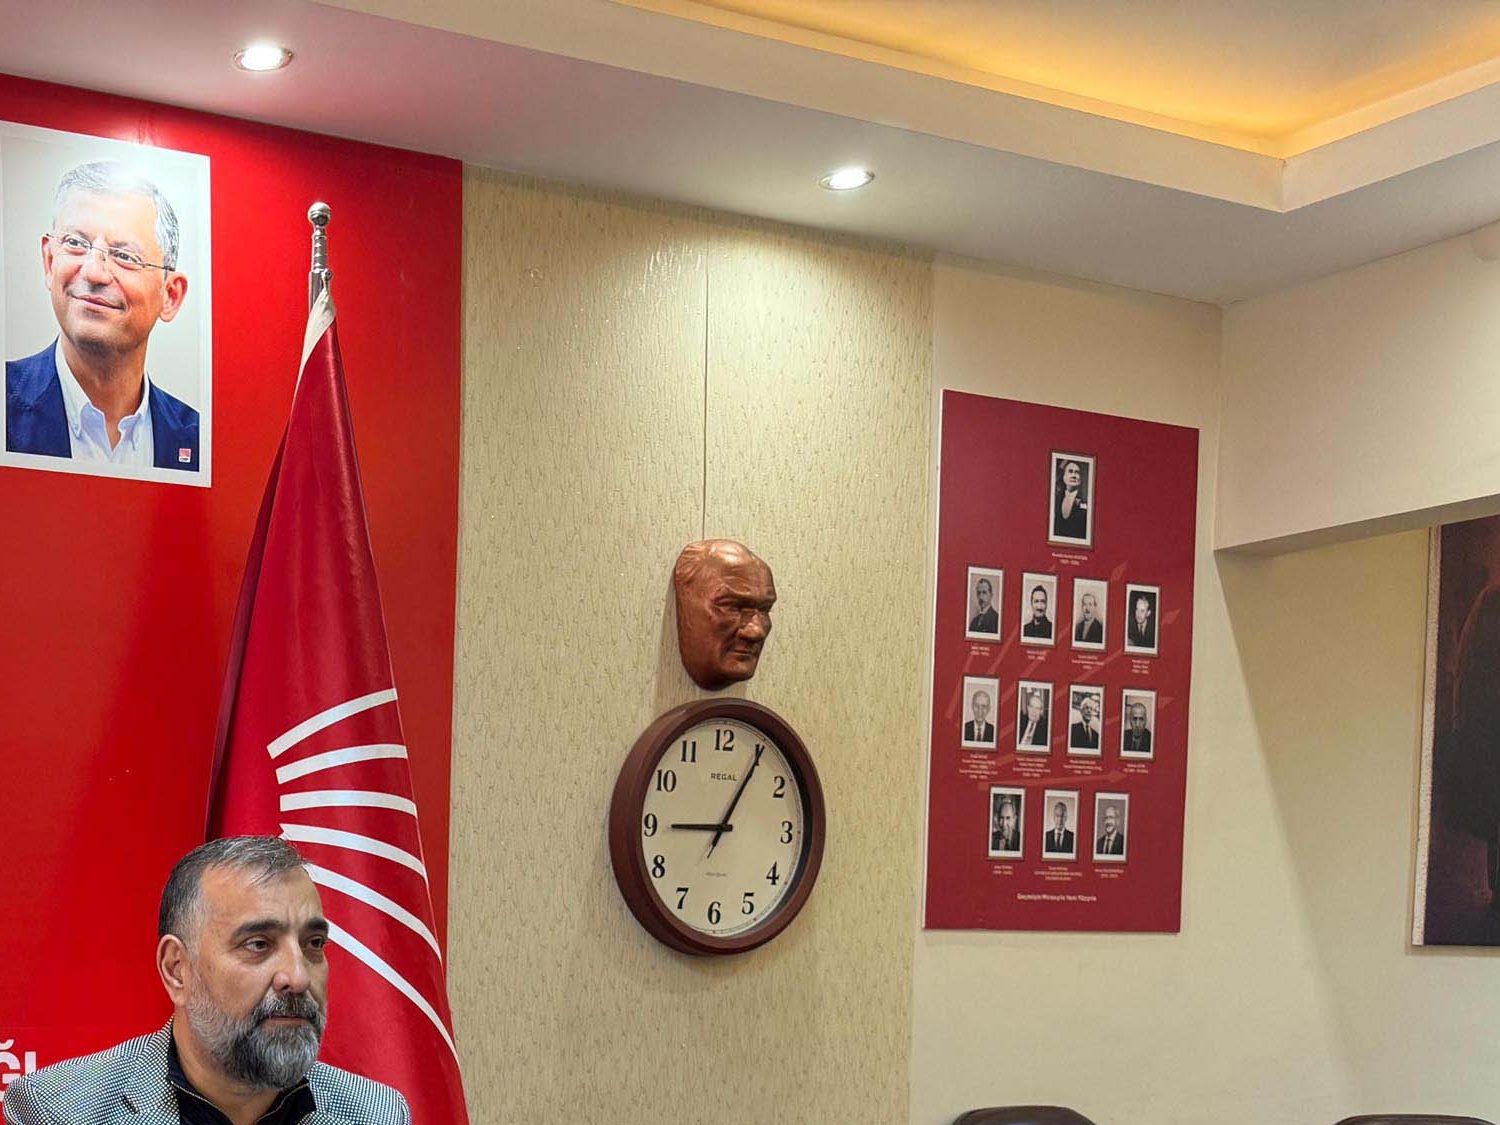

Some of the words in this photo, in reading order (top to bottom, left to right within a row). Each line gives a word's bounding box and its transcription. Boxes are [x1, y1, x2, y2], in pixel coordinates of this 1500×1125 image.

[681, 740, 697, 763] 11
[714, 729, 735, 751] 12
[656, 769, 677, 792] 10
[710, 773, 737, 782] REGAL
[772, 775, 786, 799] 2
[643, 813, 658, 837] 9
[780, 820, 793, 844] 3
[651, 854, 666, 878] 8
[766, 861, 780, 885] 4
[676, 887, 690, 909] 7
[741, 891, 755, 915] 5
[707, 901, 722, 925] 6
